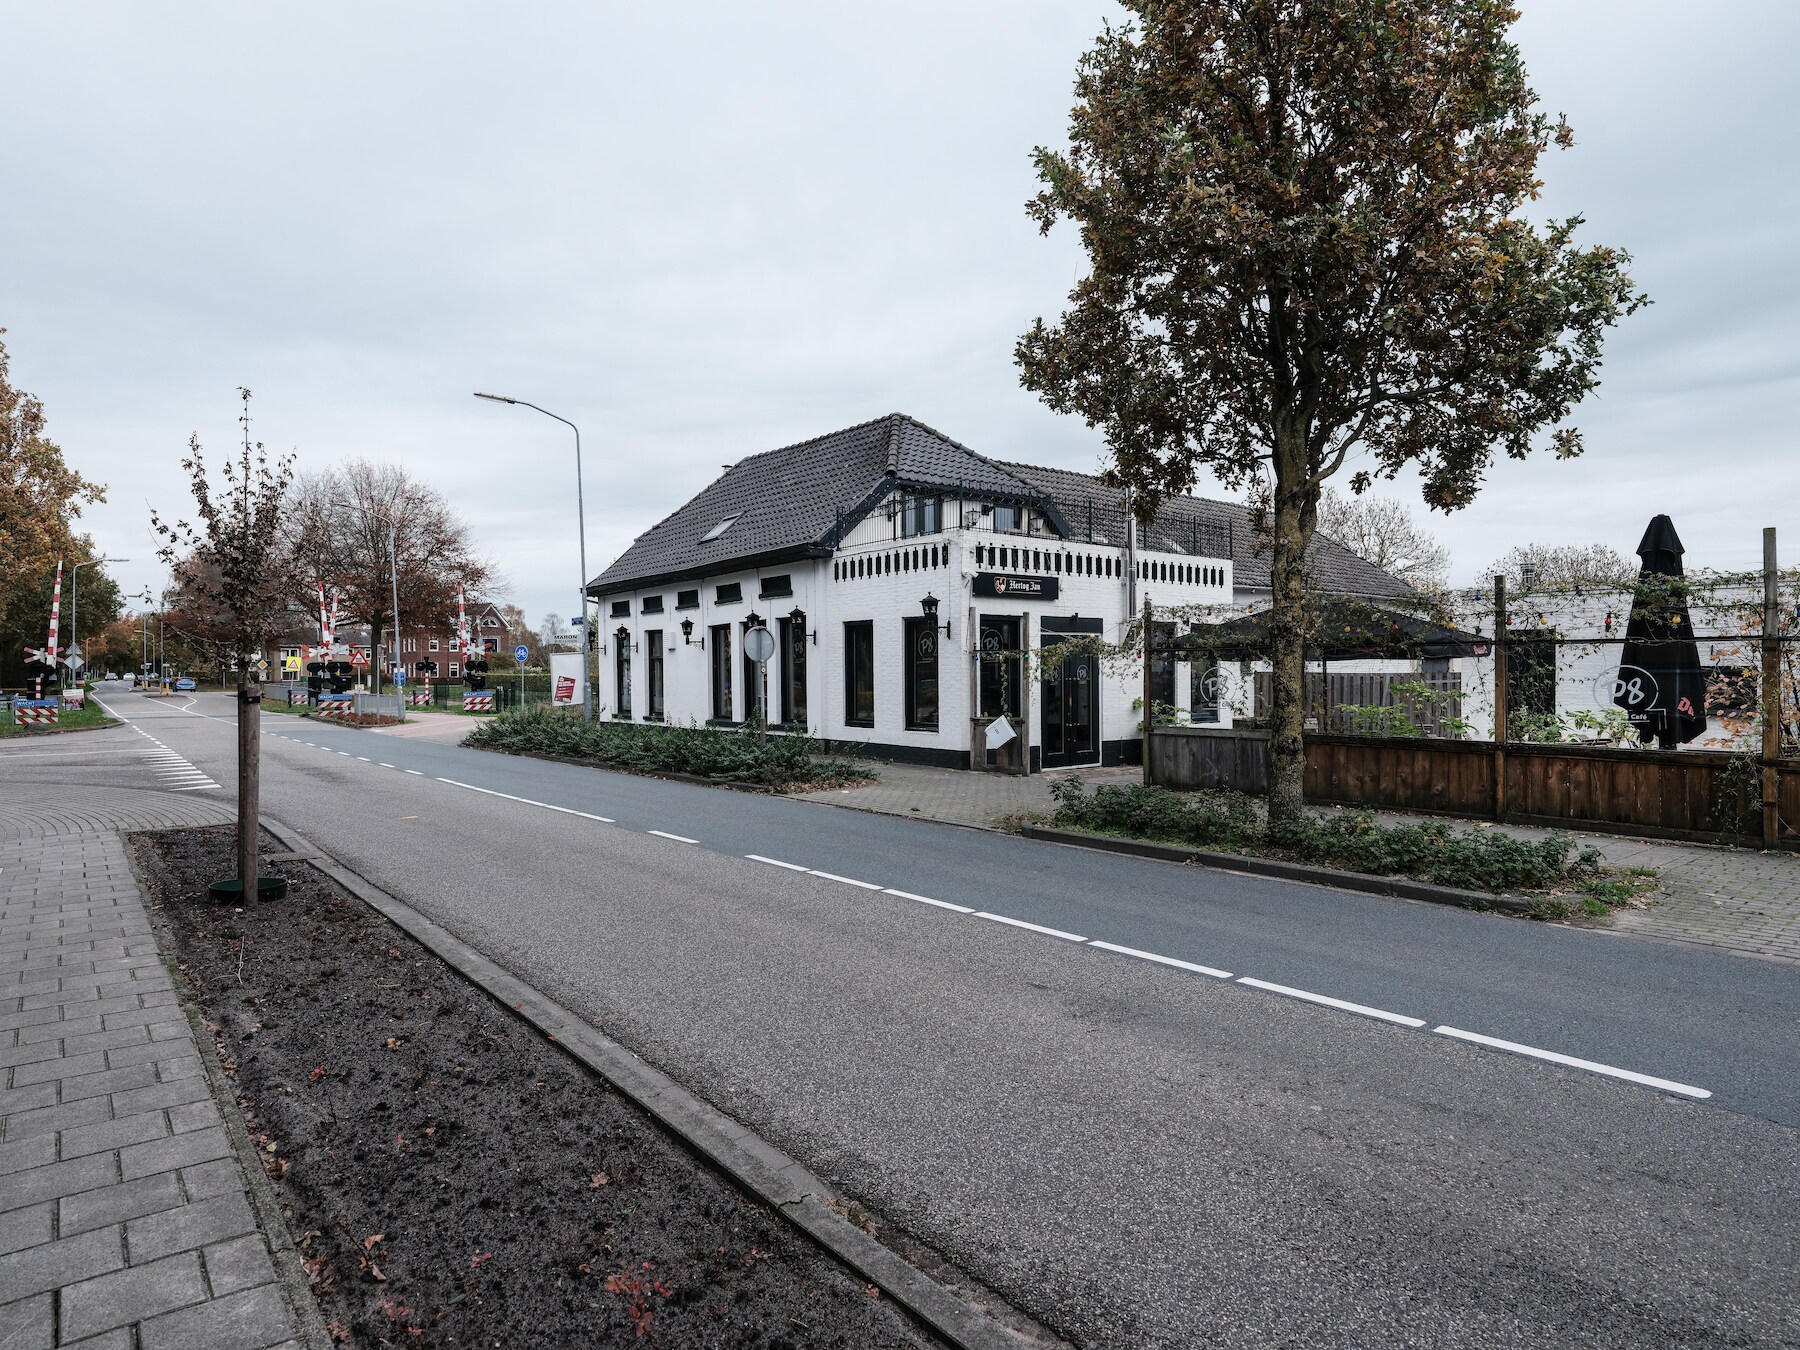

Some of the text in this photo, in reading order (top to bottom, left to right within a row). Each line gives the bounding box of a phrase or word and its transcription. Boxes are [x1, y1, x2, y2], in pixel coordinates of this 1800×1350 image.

[1009, 580, 1041, 591] Hertog Jan
[1601, 677, 1645, 706] P8
